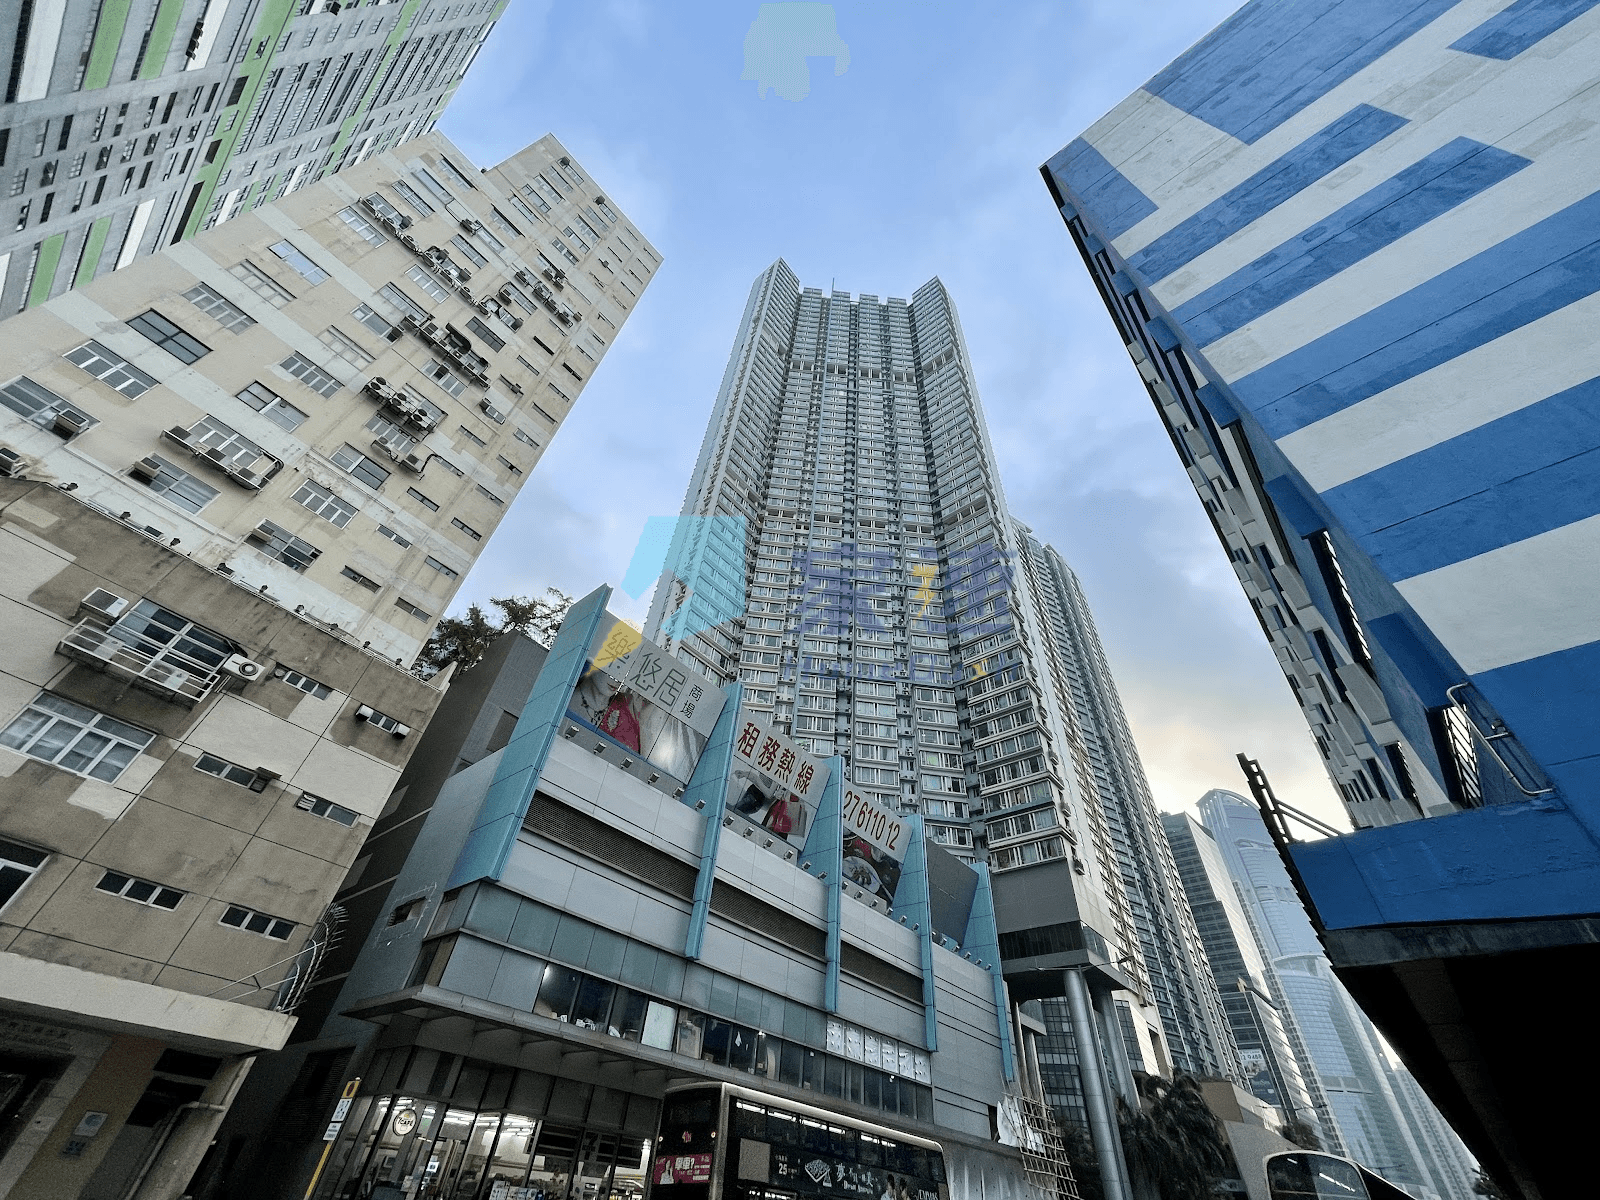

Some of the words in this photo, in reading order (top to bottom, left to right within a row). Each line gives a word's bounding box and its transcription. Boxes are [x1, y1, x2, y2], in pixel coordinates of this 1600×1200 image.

[597, 628, 686, 706] 樂悠居
[680, 683, 704, 719] 商場
[737, 722, 815, 795] 租務熱線
